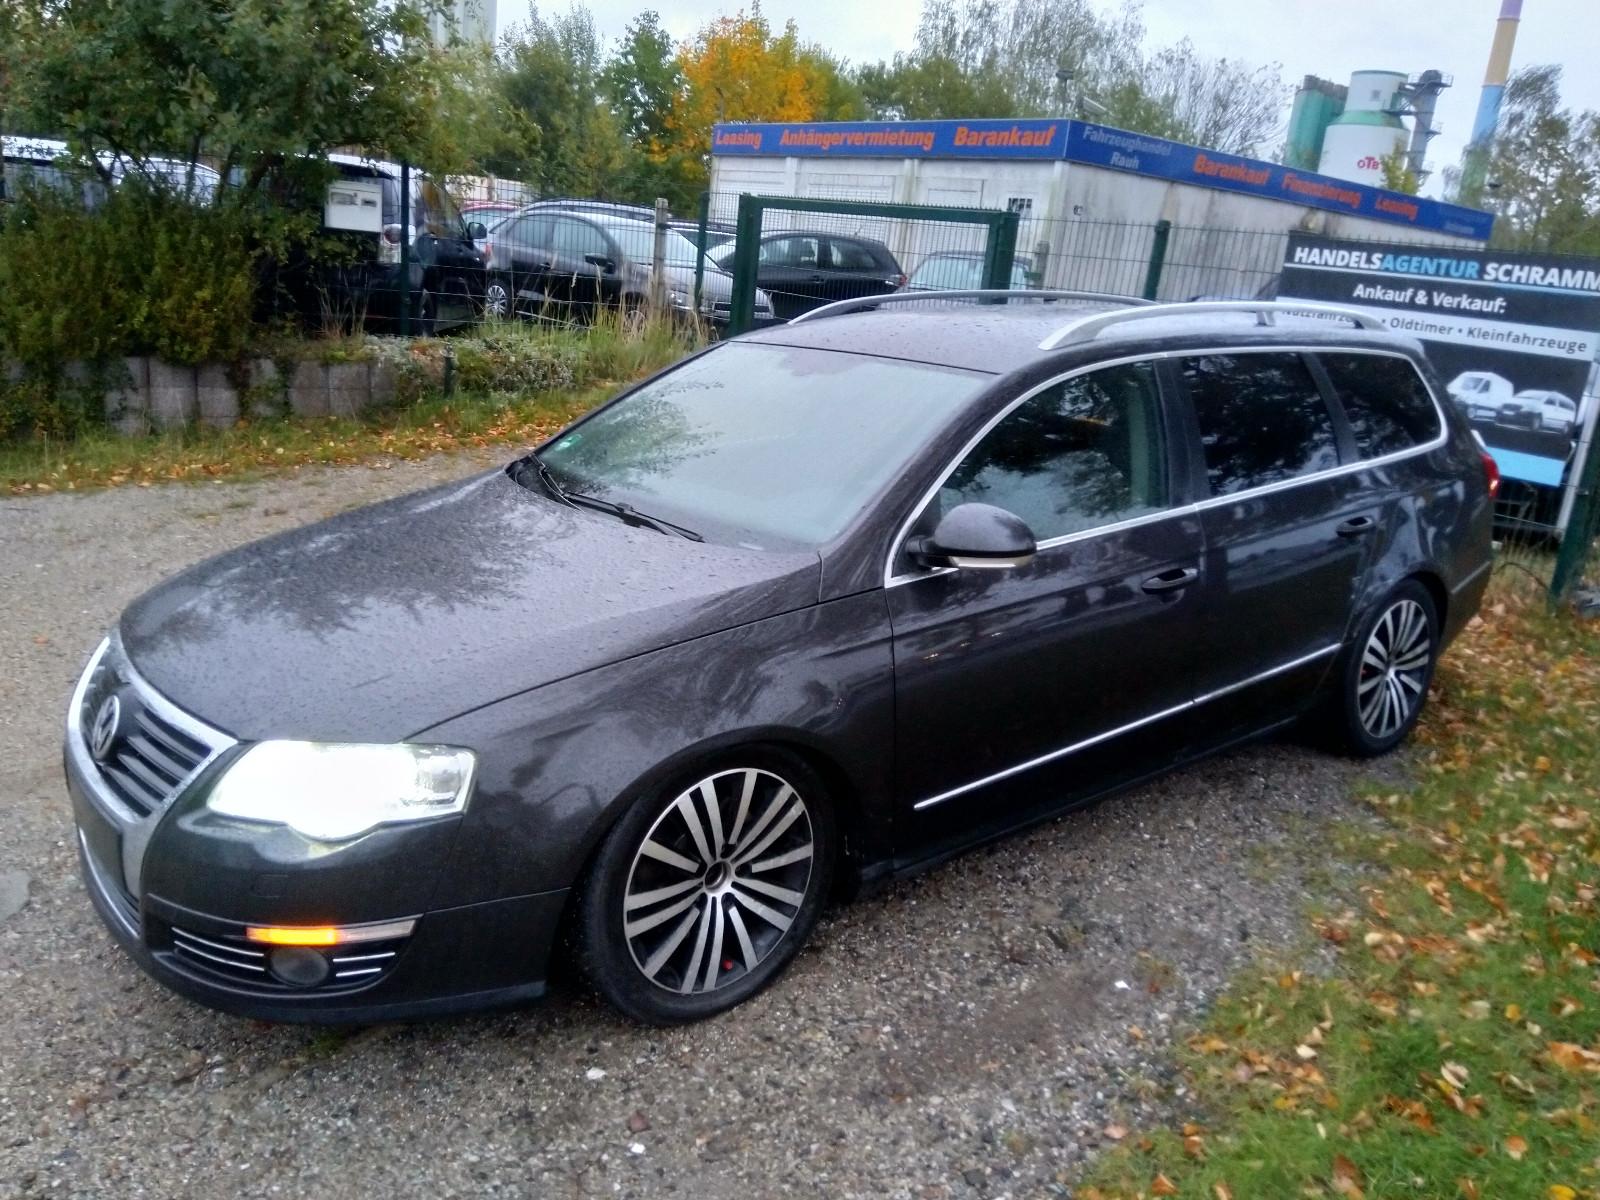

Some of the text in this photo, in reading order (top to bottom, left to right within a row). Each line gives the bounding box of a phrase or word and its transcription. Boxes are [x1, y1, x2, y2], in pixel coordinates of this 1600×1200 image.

[715, 125, 1057, 151] Leasing Anhängervermietung Barankauf
[1083, 125, 1173, 156] Fahrzeughandel
[1193, 153, 1272, 186] Barankauf
[1294, 246, 1480, 280] HANDELSAGENTUR
[1353, 283, 1507, 314] Ankauf & Verkauf:
[1390, 316, 1454, 336] Oldtimer
[1466, 326, 1588, 354] Kleinfahrzeuge
